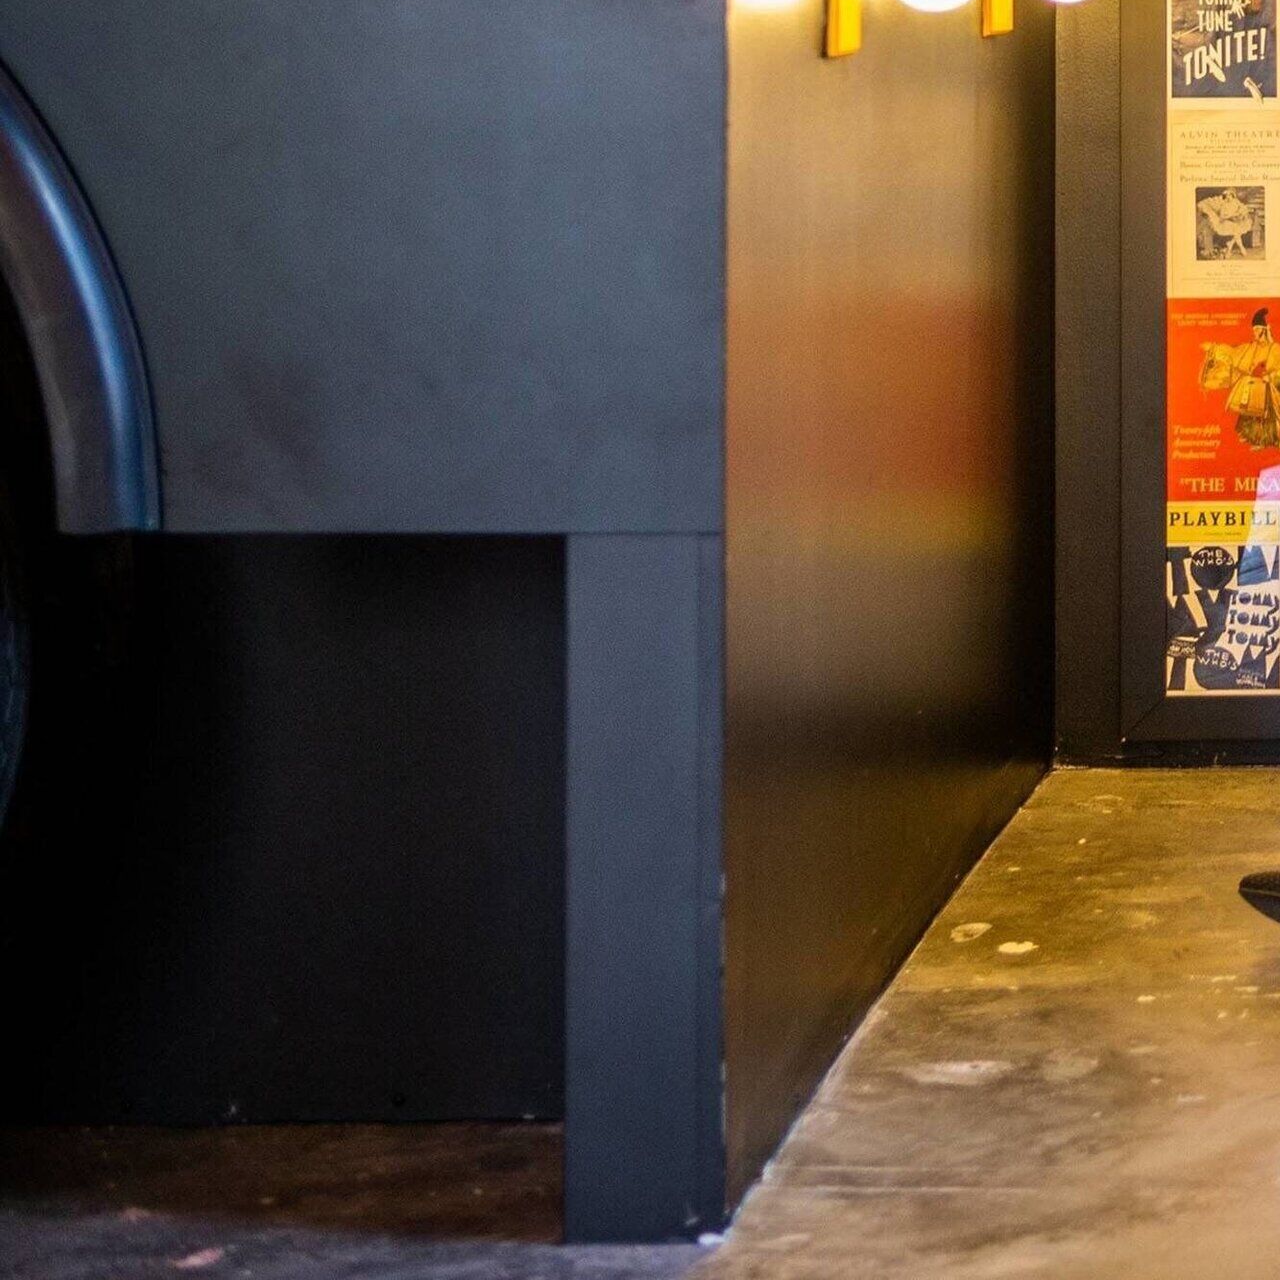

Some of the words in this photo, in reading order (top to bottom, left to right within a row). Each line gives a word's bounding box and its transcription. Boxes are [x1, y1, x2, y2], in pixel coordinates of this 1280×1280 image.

[1199, 9, 1234, 33] TUNE
[1183, 28, 1267, 85] TONITE!
[1169, 511, 1276, 527] PLAYBILL
[1229, 590, 1280, 609] TOMMY
[1228, 609, 1280, 630] TOMMY
[1227, 629, 1279, 654] TOMMY
